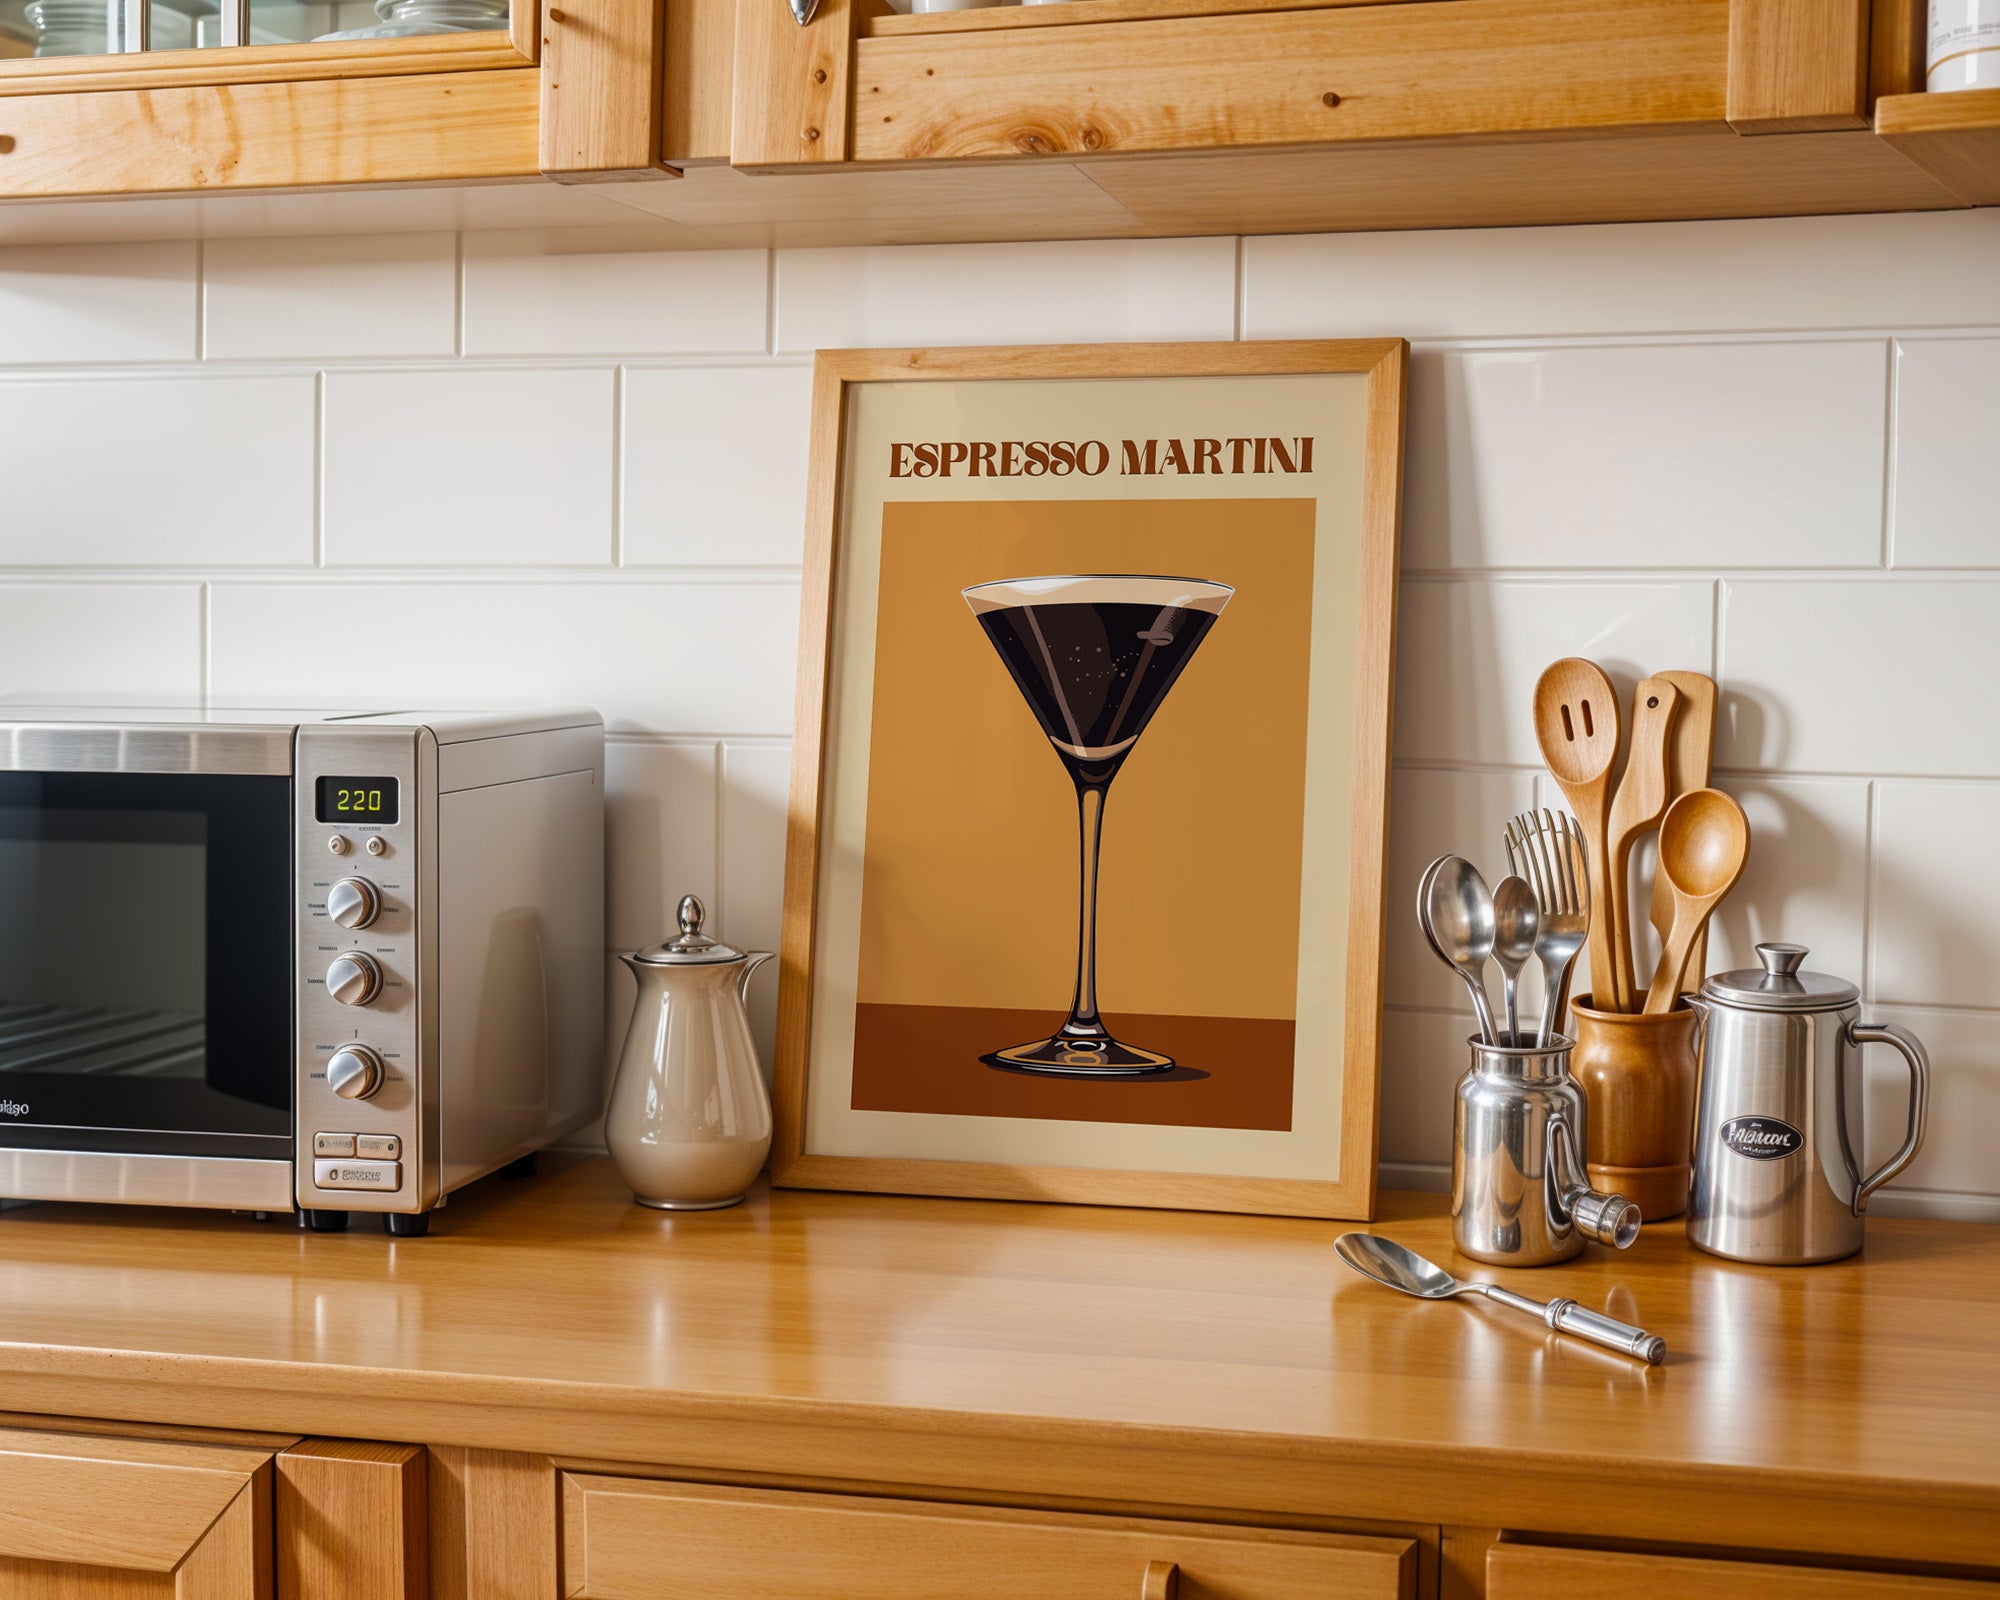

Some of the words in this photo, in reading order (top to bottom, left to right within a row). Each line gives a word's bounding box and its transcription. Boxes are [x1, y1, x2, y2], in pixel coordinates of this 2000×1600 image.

[889, 441, 1109, 478] ESPRESSO
[1120, 437, 1314, 475] MARTINI
[337, 789, 381, 811] 220
